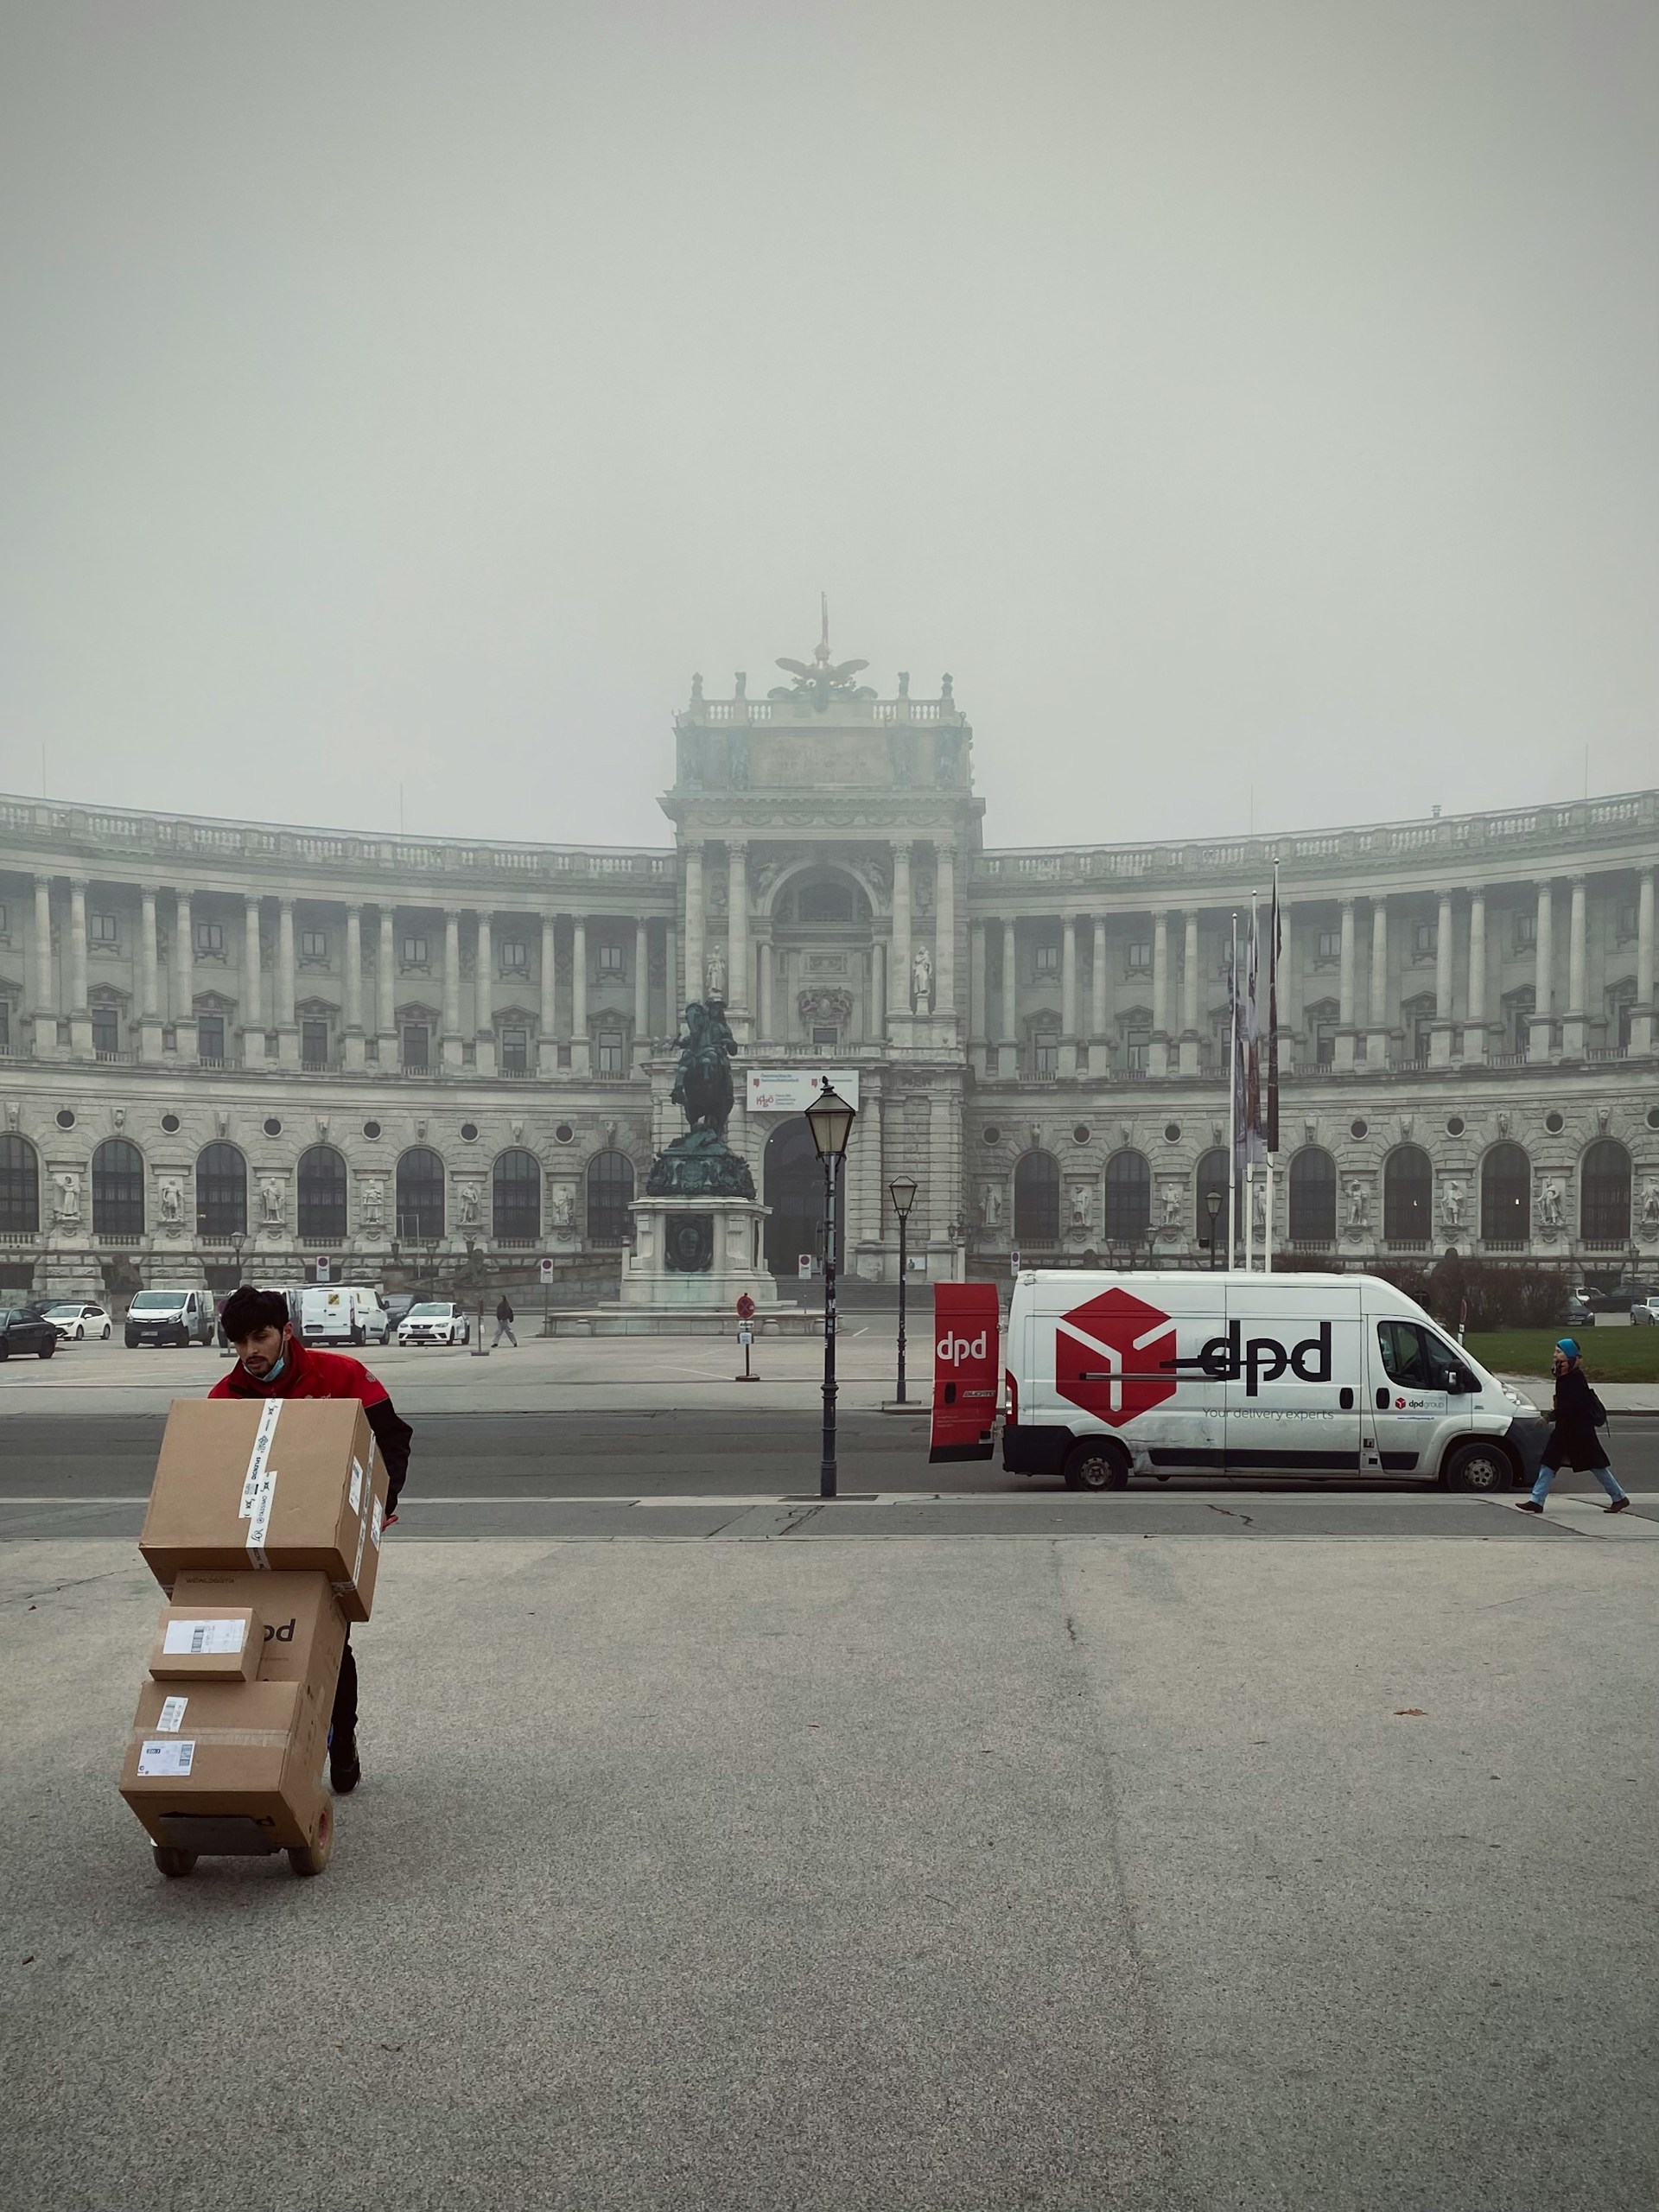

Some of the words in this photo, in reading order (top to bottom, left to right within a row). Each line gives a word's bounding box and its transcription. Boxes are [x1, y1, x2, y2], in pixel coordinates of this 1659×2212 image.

[937, 1331, 987, 1367] dpd
[1200, 1319, 1332, 1397] dpd
[1203, 1408, 1230, 1419] Your
[1233, 1408, 1284, 1421] delivery
[1286, 1409, 1334, 1421] experts
